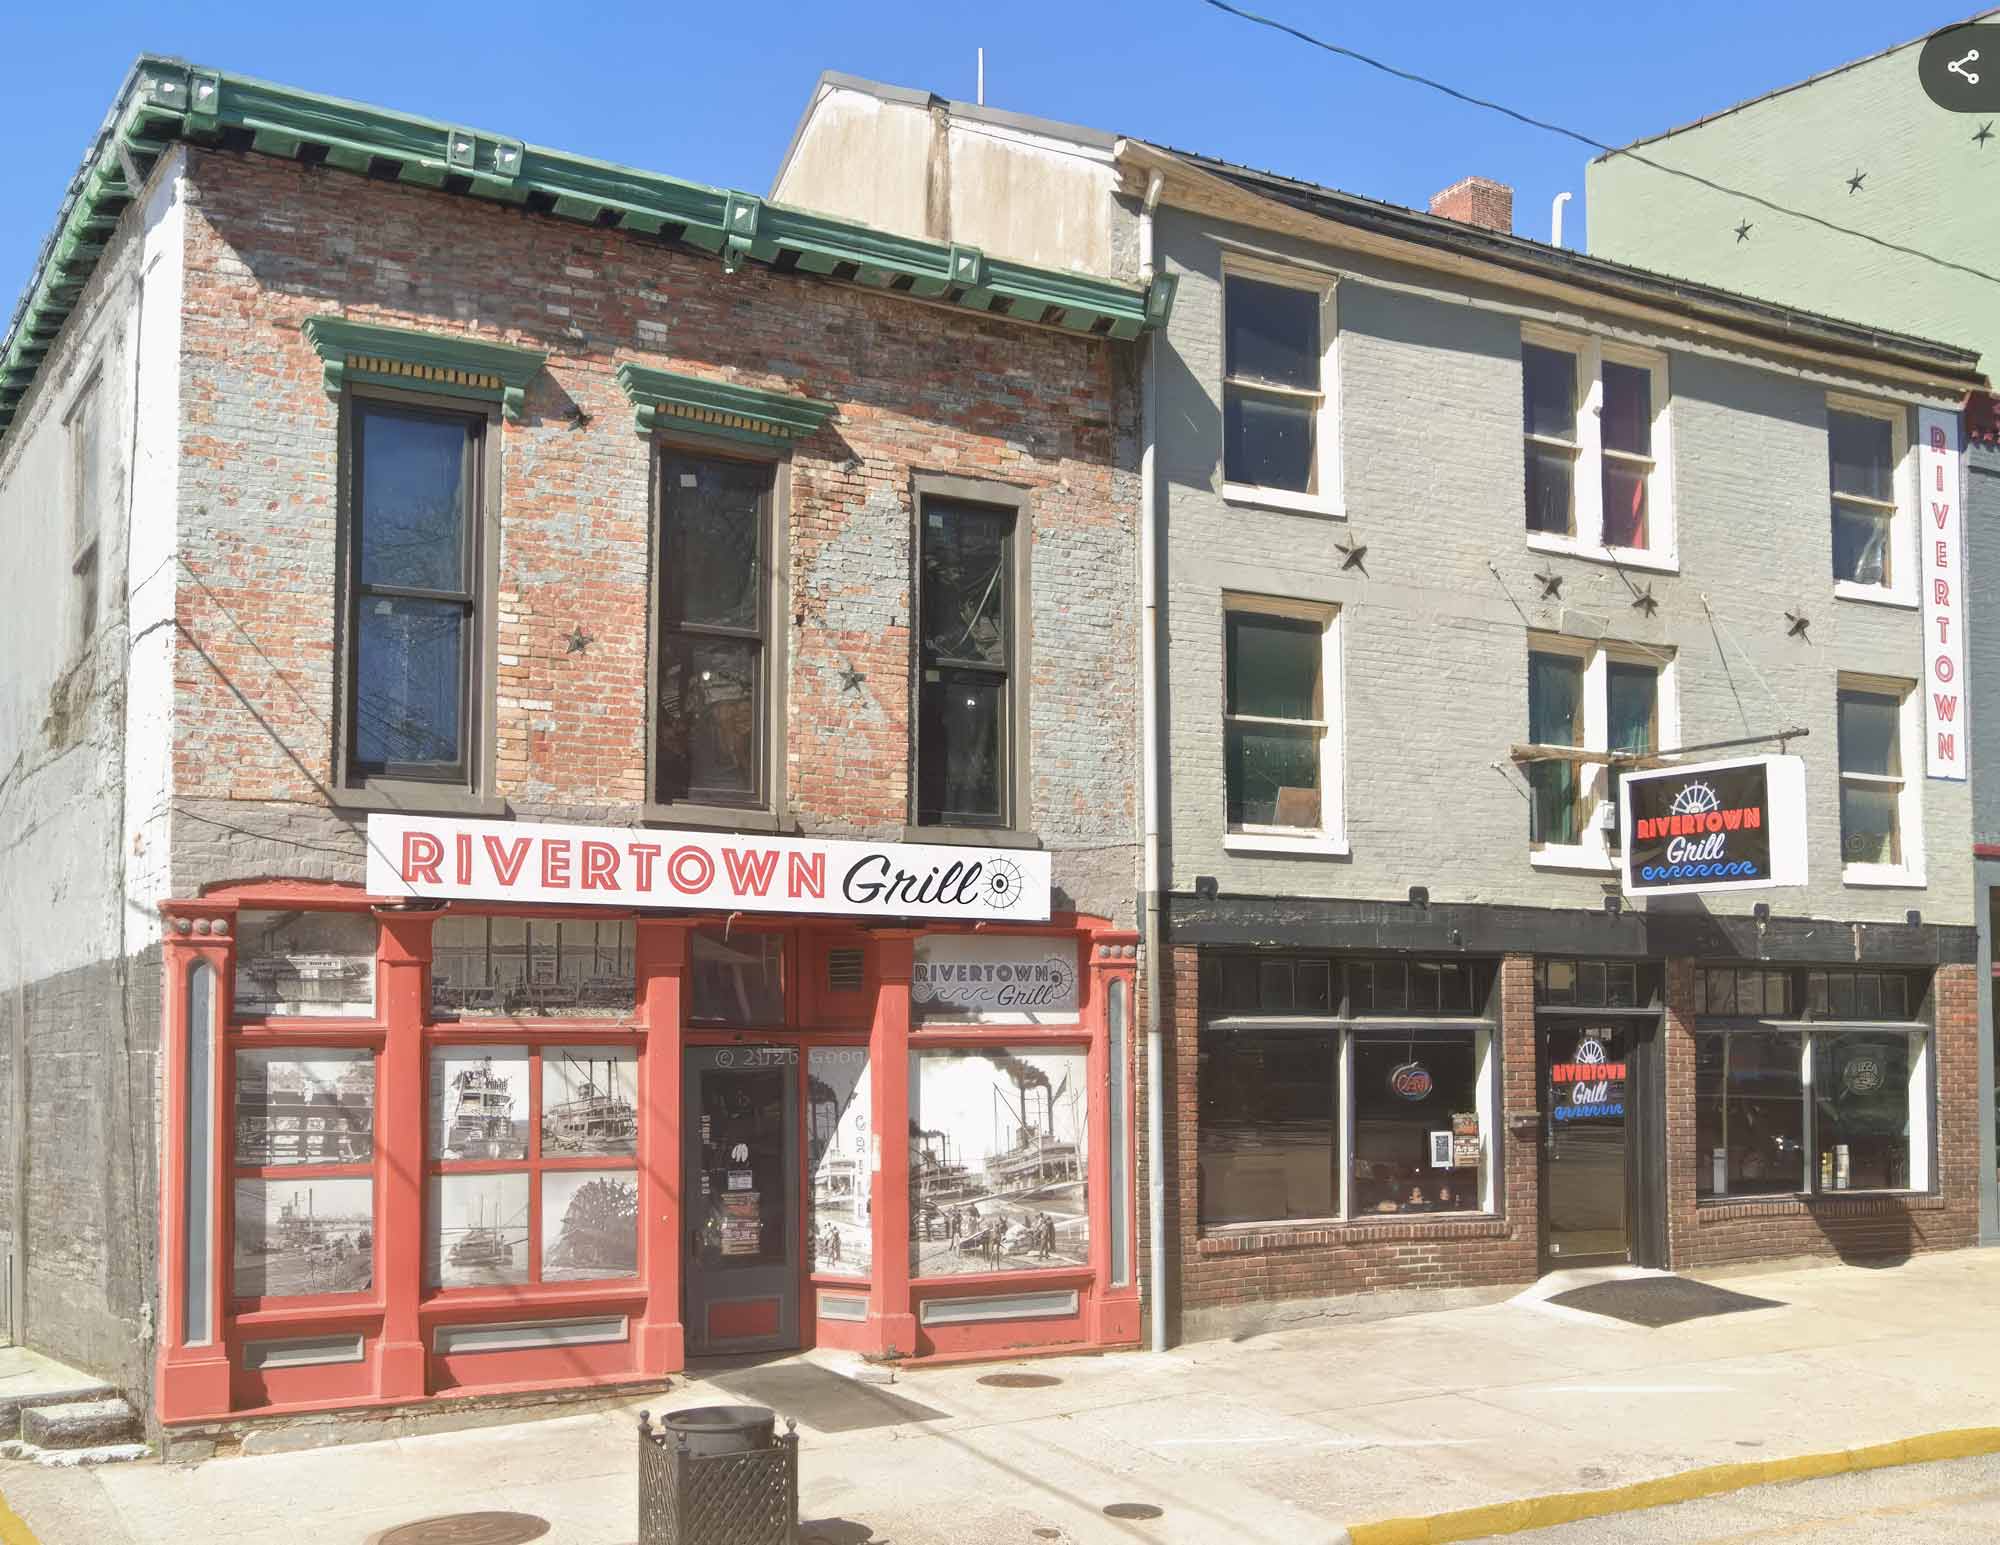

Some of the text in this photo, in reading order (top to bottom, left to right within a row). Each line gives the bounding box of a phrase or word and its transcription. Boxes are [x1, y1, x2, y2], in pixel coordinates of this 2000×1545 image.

[1930, 425, 1957, 761] RIVERTOWN
[1637, 807, 1761, 840] RIVERTOWN
[1667, 832, 1726, 864] Grill
[402, 831, 982, 905] RIVERTOWN Grill
[914, 963, 1048, 983] RIVERTOWN
[997, 984, 1052, 1006] Grill
[1572, 1080, 1608, 1105] Grill
